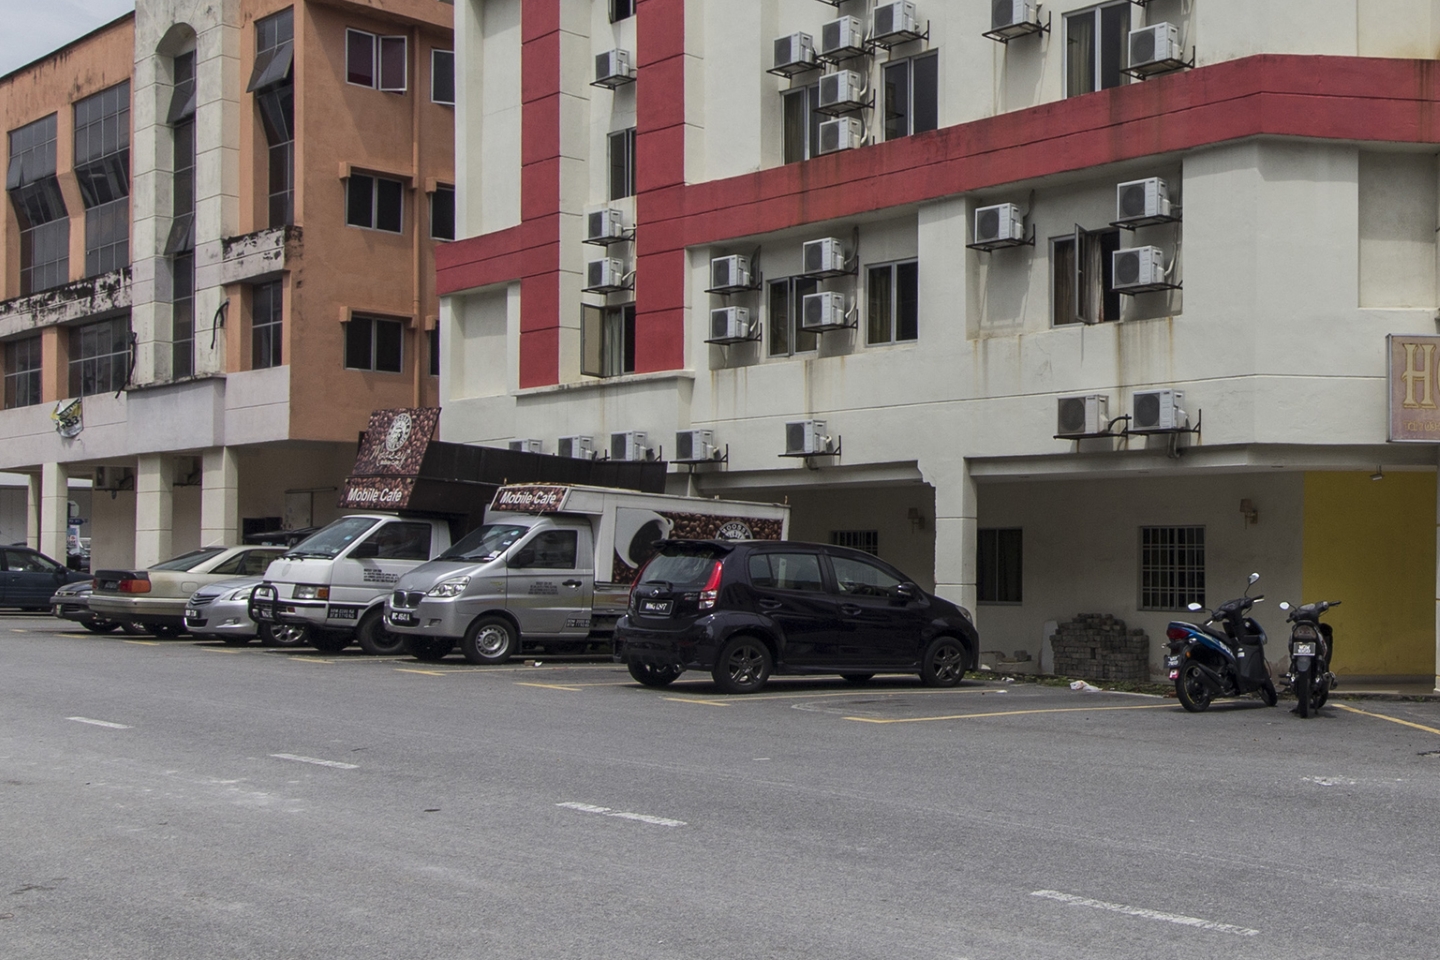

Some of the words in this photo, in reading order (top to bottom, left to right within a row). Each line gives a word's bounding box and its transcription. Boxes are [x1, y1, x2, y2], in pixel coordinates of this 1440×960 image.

[347, 488, 378, 502] Mobile
[379, 488, 402, 502] Cafe
[500, 491, 532, 504] Mobile
[534, 491, 557, 504] Cafe
